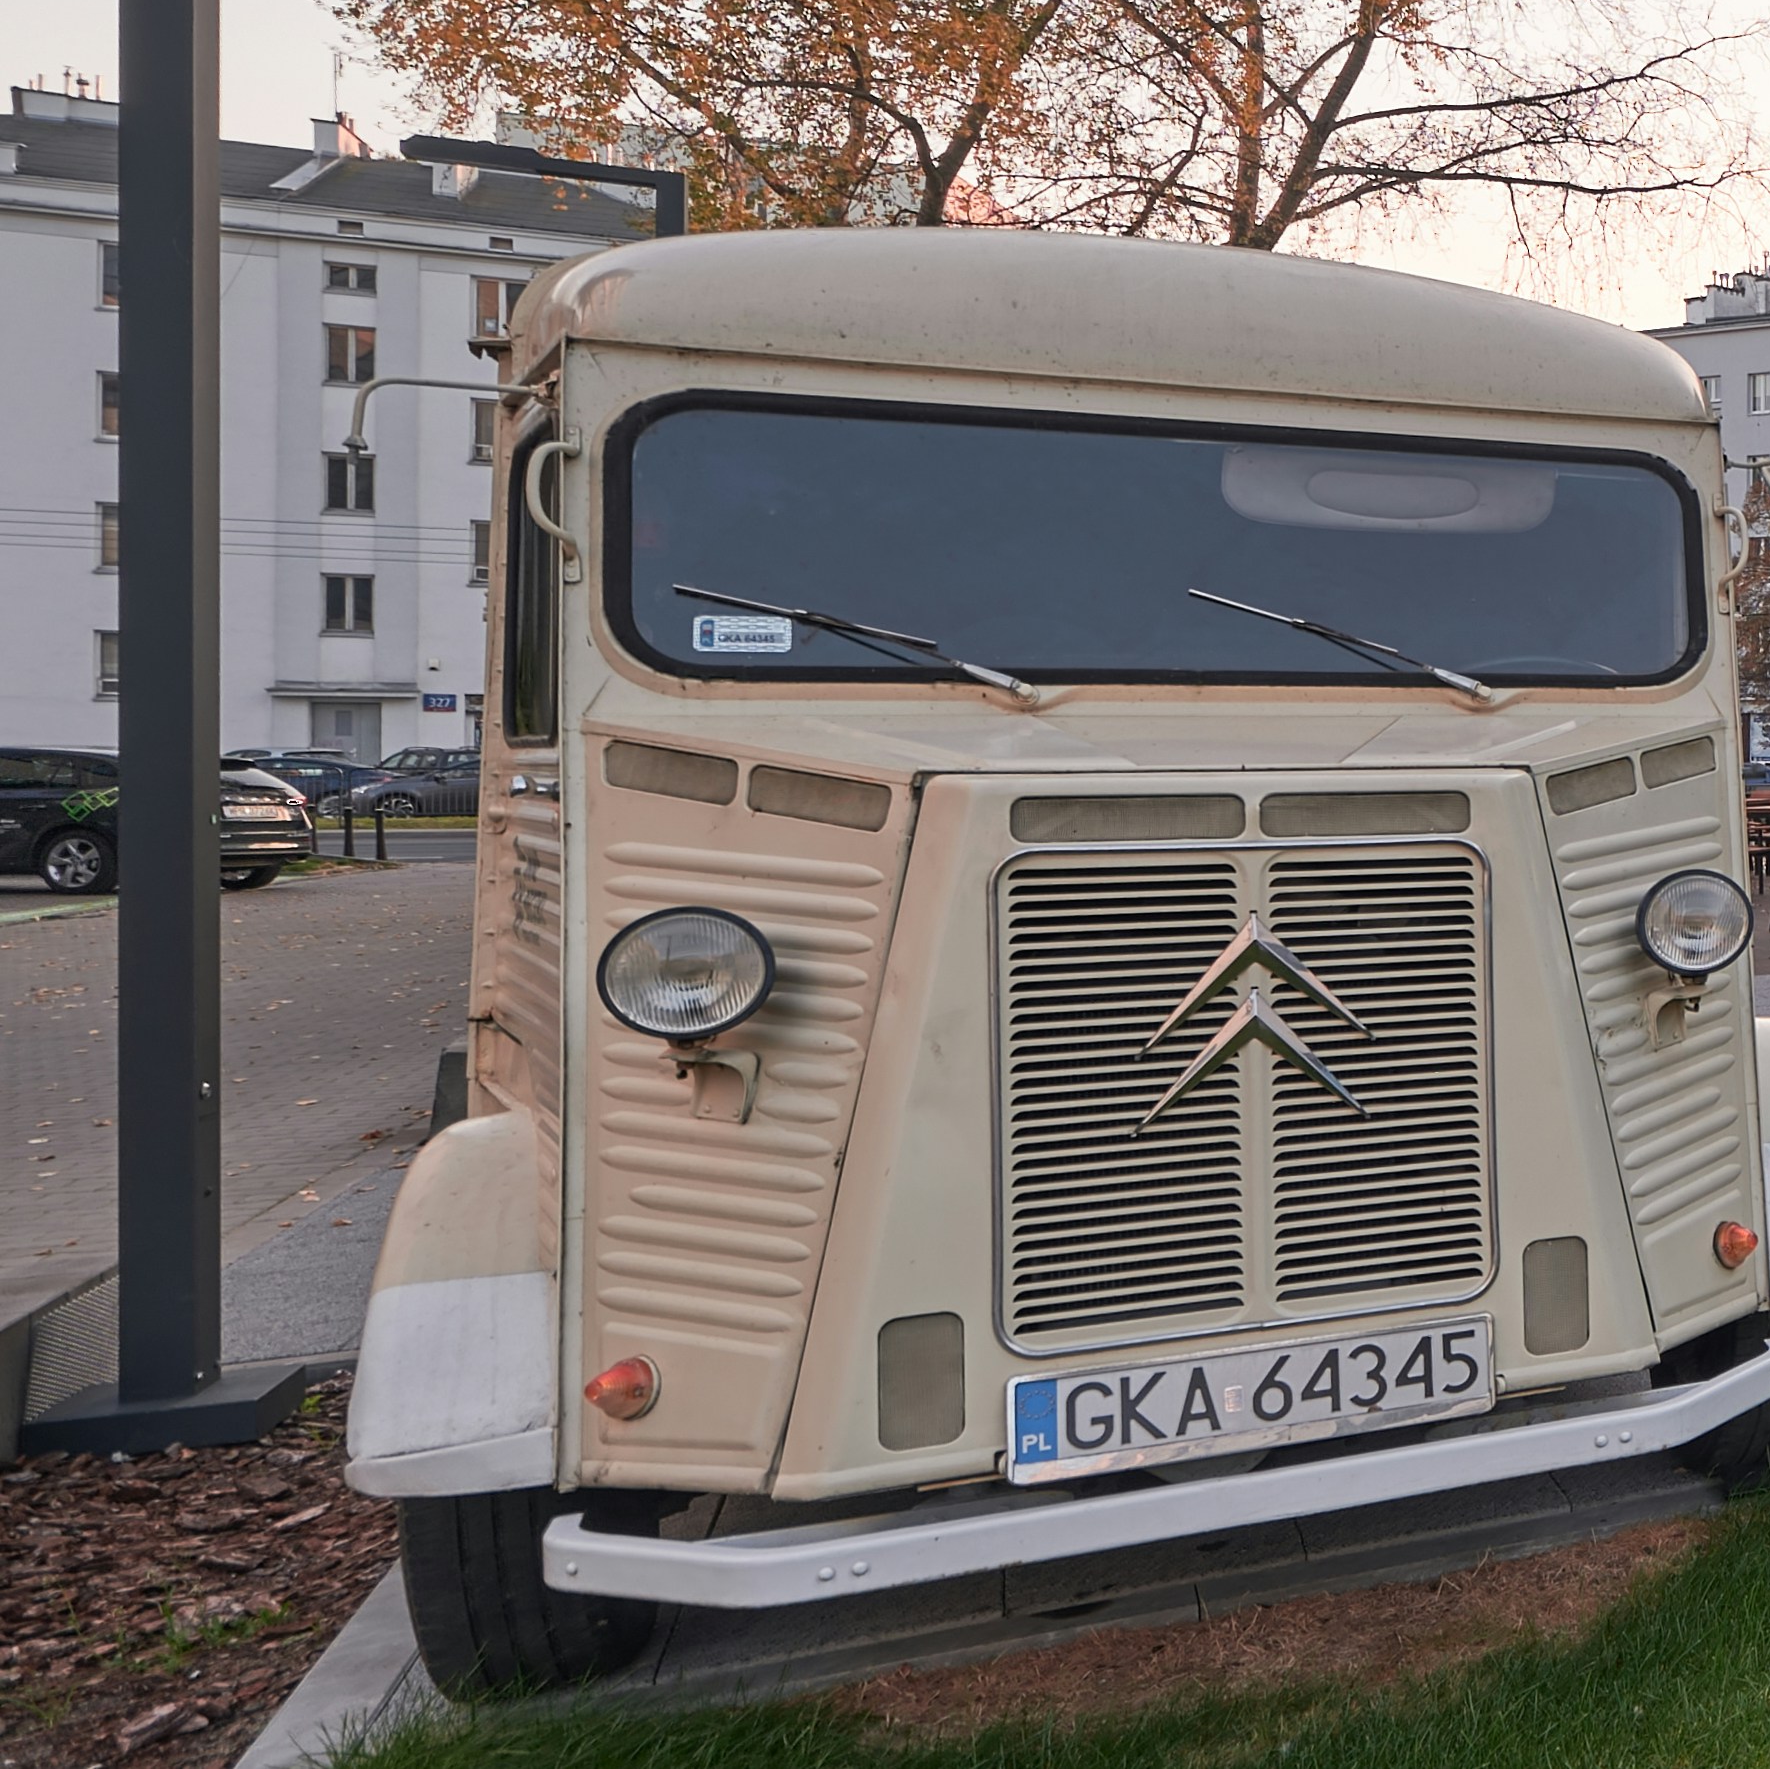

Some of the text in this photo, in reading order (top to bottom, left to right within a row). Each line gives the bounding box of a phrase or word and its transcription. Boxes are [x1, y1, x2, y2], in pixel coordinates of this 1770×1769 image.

[429, 697, 450, 707] 327
[1065, 1330, 1479, 1450] GKA 64345
[1022, 1433, 1052, 1454] PL
